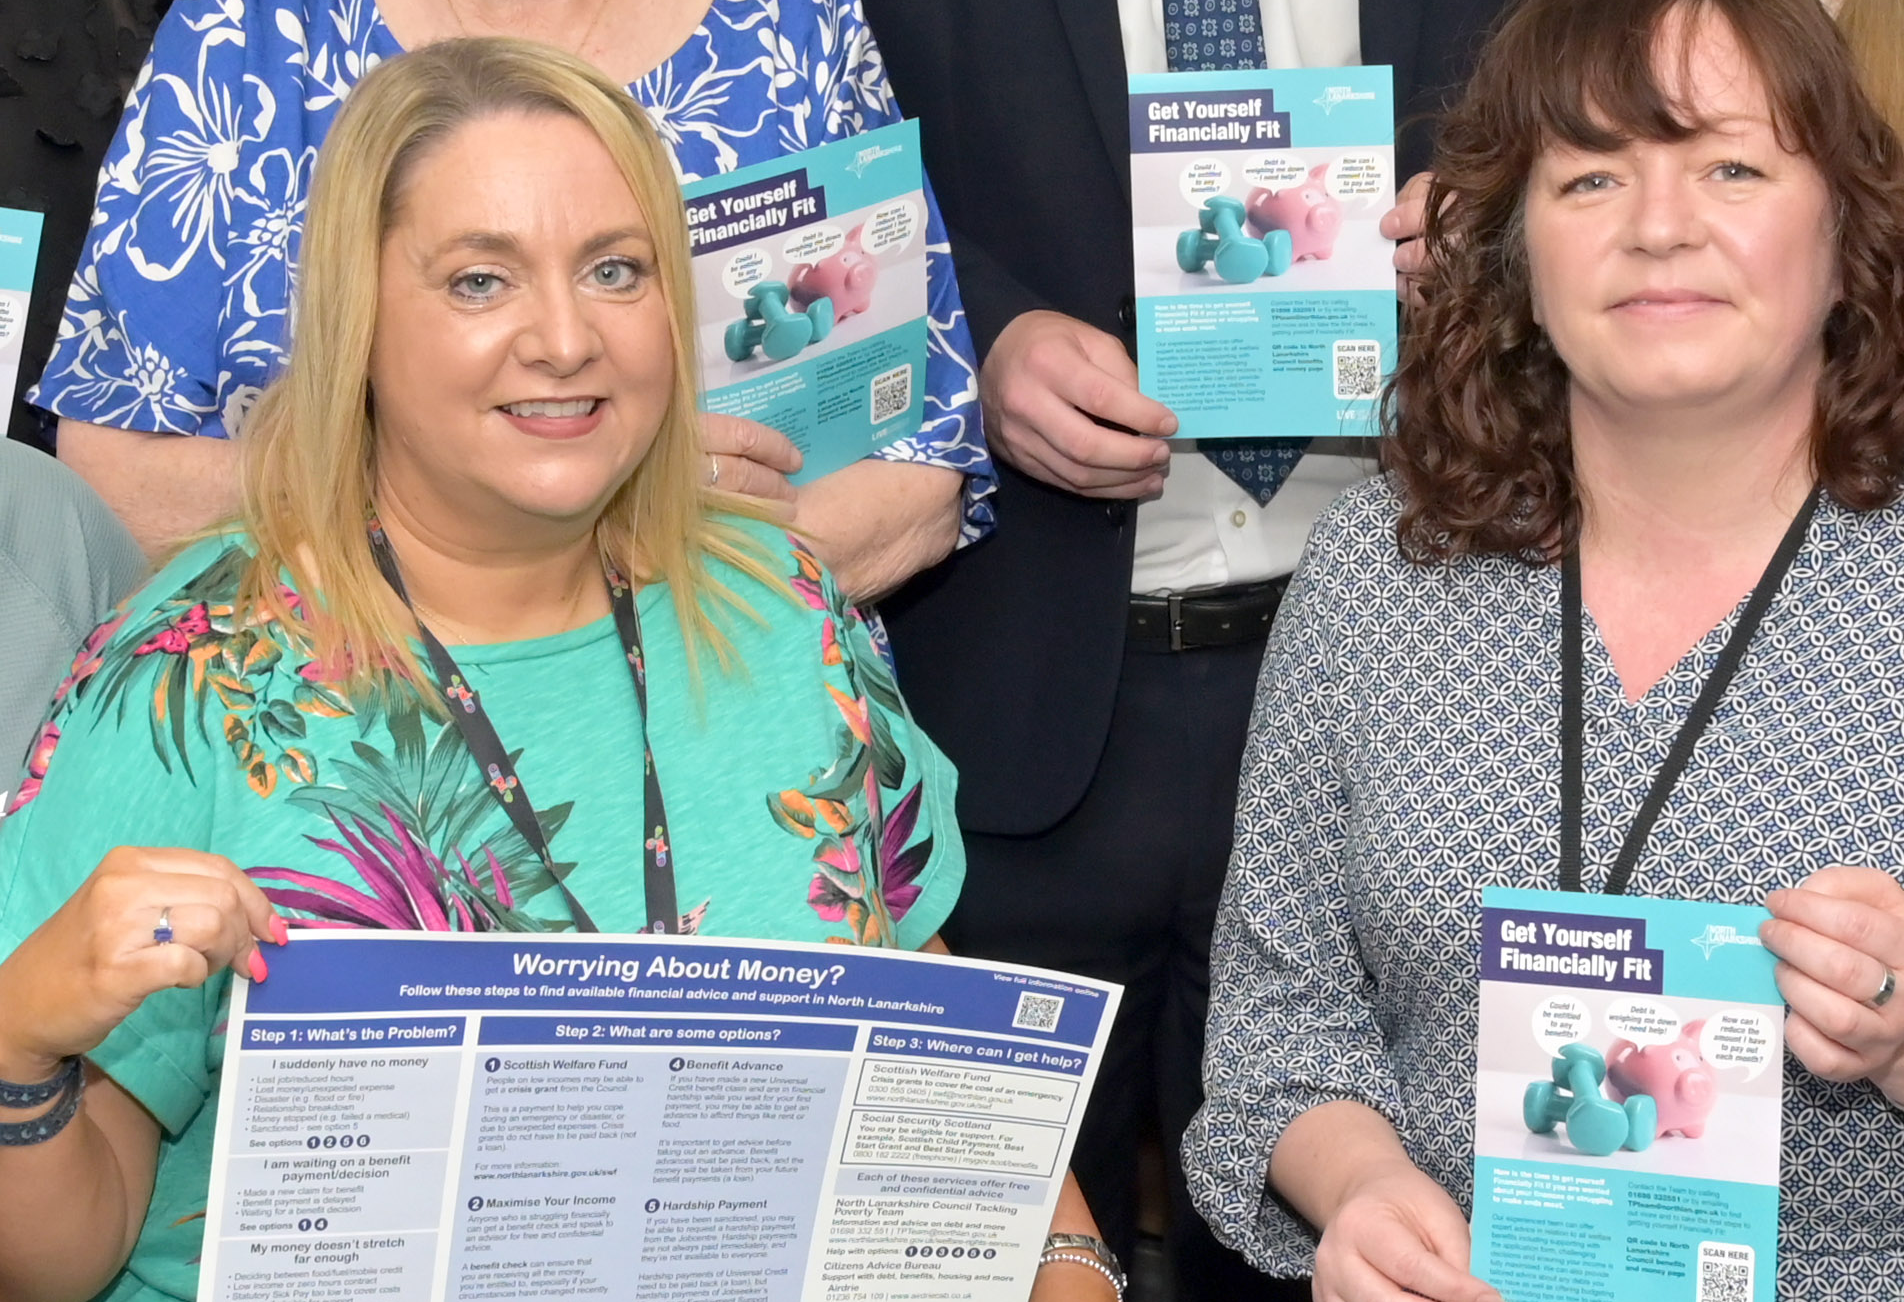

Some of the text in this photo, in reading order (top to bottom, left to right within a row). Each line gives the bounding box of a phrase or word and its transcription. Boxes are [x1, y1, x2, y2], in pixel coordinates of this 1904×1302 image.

[1148, 98, 1262, 121] Get Yourself
[1149, 120, 1281, 143] Financially Fit
[686, 179, 798, 226] Get Yourself
[689, 197, 817, 247] Financially Fit
[1500, 919, 1633, 953] Get Yourself
[513, 952, 845, 990] Worrying About Money?
[1500, 947, 1652, 982] Financially Fit
[399, 984, 945, 1015] Follow these steps to find available financial advice and support in North Lanarkshire
[251, 1029, 286, 1044] Step
[290, 1029, 303, 1042] 1:
[361, 1027, 384, 1040] the
[388, 1026, 457, 1040] Problem?
[555, 1024, 782, 1042] Step 2: What are some options?
[272, 1057, 429, 1071] I suddenly have no money
[873, 1034, 1082, 1071] Step 3: Where can I get help?
[503, 1060, 628, 1071] Scottish Welfare Fund
[486, 1195, 616, 1209] Maximise Your Income
[1703, 1248, 1749, 1260] SCAN HERE
